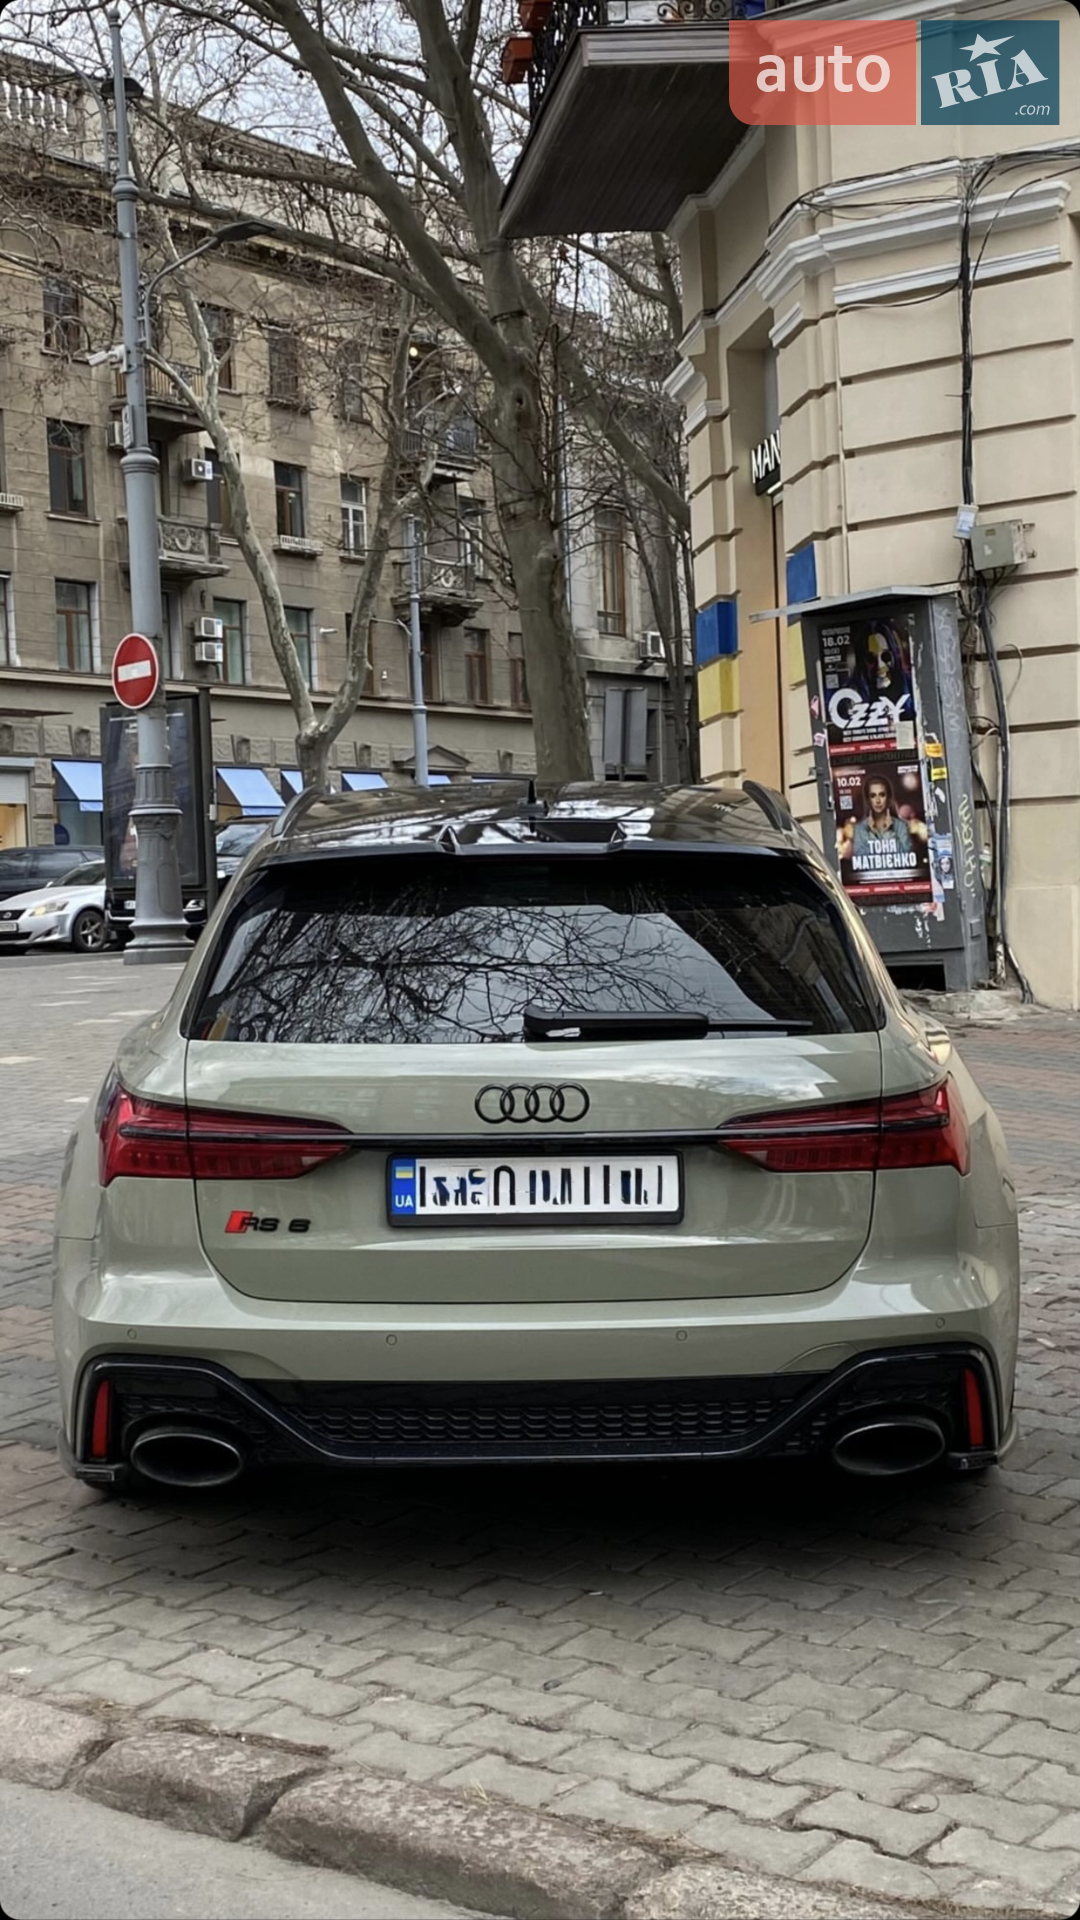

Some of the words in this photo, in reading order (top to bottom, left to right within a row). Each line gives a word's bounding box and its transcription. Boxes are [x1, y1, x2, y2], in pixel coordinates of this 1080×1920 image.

[822, 635, 851, 647] 18.02
[837, 776, 862, 787] 10.02
[868, 838, 897, 854] ТОНЯ
[852, 852, 917, 871] МАТВІЄНКО
[394, 1194, 414, 1208] UA
[236, 1215, 281, 1232] RS
[288, 1217, 312, 1233] 6
